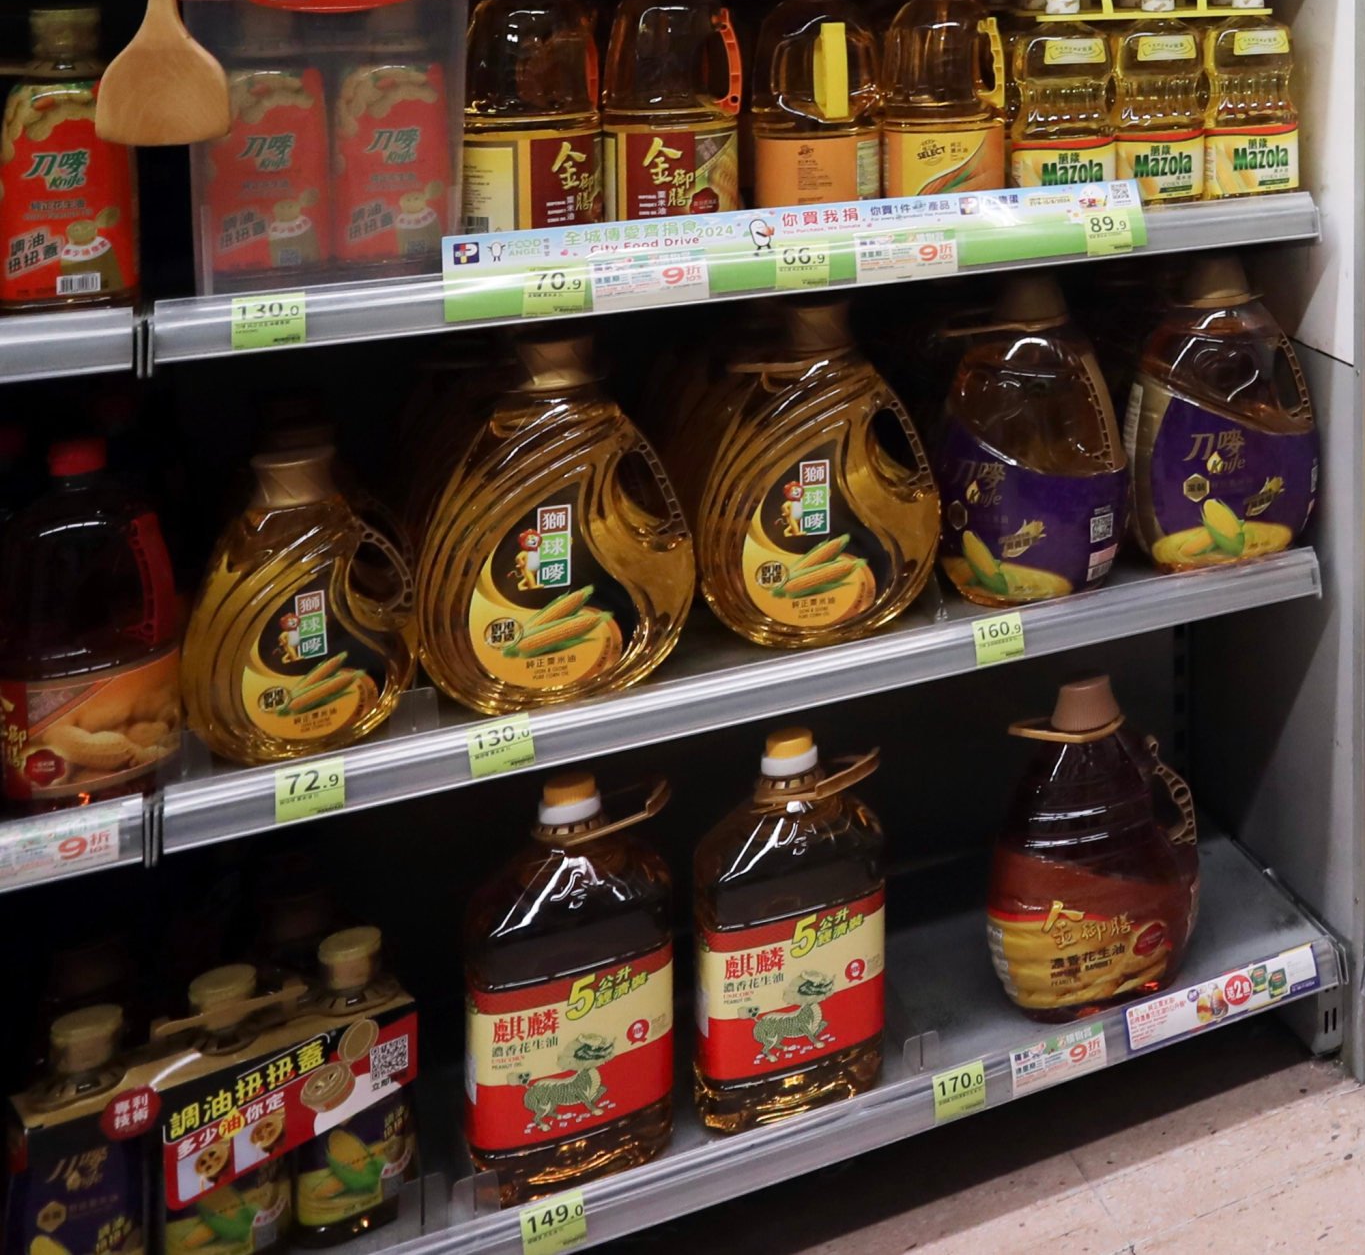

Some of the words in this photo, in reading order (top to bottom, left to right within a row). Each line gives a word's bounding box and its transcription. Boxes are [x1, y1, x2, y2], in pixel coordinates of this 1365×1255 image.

[239, 133, 296, 160] 刀嘜
[364, 126, 420, 154] 刀嘜
[24, 150, 91, 178] 刀嘜
[916, 146, 947, 161] SELECT
[1133, 153, 1194, 179] Mazola
[1233, 145, 1289, 171] Mazola
[48, 172, 86, 191] Knife
[551, 141, 599, 215] 金御膳
[642, 137, 695, 208] 金御膳
[1041, 160, 1104, 186] Mazola
[781, 208, 861, 228] 你買我捐
[870, 200, 911, 216] 你買1件
[928, 199, 951, 212] 產品
[564, 220, 698, 246] 全城傳愛齊捐食
[696, 225, 734, 239] 2024
[1089, 214, 1128, 235] 89.9
[10, 233, 46, 254] 調油
[663, 235, 700, 250] Drive
[8, 242, 59, 274] 扭扭蓋
[533, 271, 583, 292] 70.9
[237, 301, 300, 321] 130.0
[1183, 431, 1246, 460] 刀嘜
[1208, 455, 1247, 474] Knife
[803, 463, 827, 534] 獅球嘜
[541, 508, 567, 583] 獅球嘜
[299, 593, 324, 655] 獅球嘜
[976, 620, 1023, 642] 160.9
[472, 724, 532, 749] 130.0
[284, 769, 340, 795] 72.9
[790, 914, 820, 960] 5
[818, 906, 851, 928] 公升
[816, 914, 865, 948] 經濟裝
[1042, 899, 1136, 952] 金御膳
[723, 946, 786, 982] 麒麟
[1049, 940, 1127, 970] 濃香花生油
[565, 976, 597, 1022] 5
[598, 965, 633, 992] 公升
[596, 972, 649, 1009] 經濟裝
[722, 971, 785, 995] 濃香花生油
[491, 1008, 561, 1043] 麒麟
[491, 1035, 560, 1059] 濃香花生油
[169, 1039, 326, 1140] 調油扭扭蓋
[937, 1070, 984, 1097] 170.0
[113, 1093, 149, 1113] 專利
[113, 1108, 150, 1130] 技術
[177, 1092, 286, 1160] 多少油你定
[525, 1203, 586, 1235] 149.0
